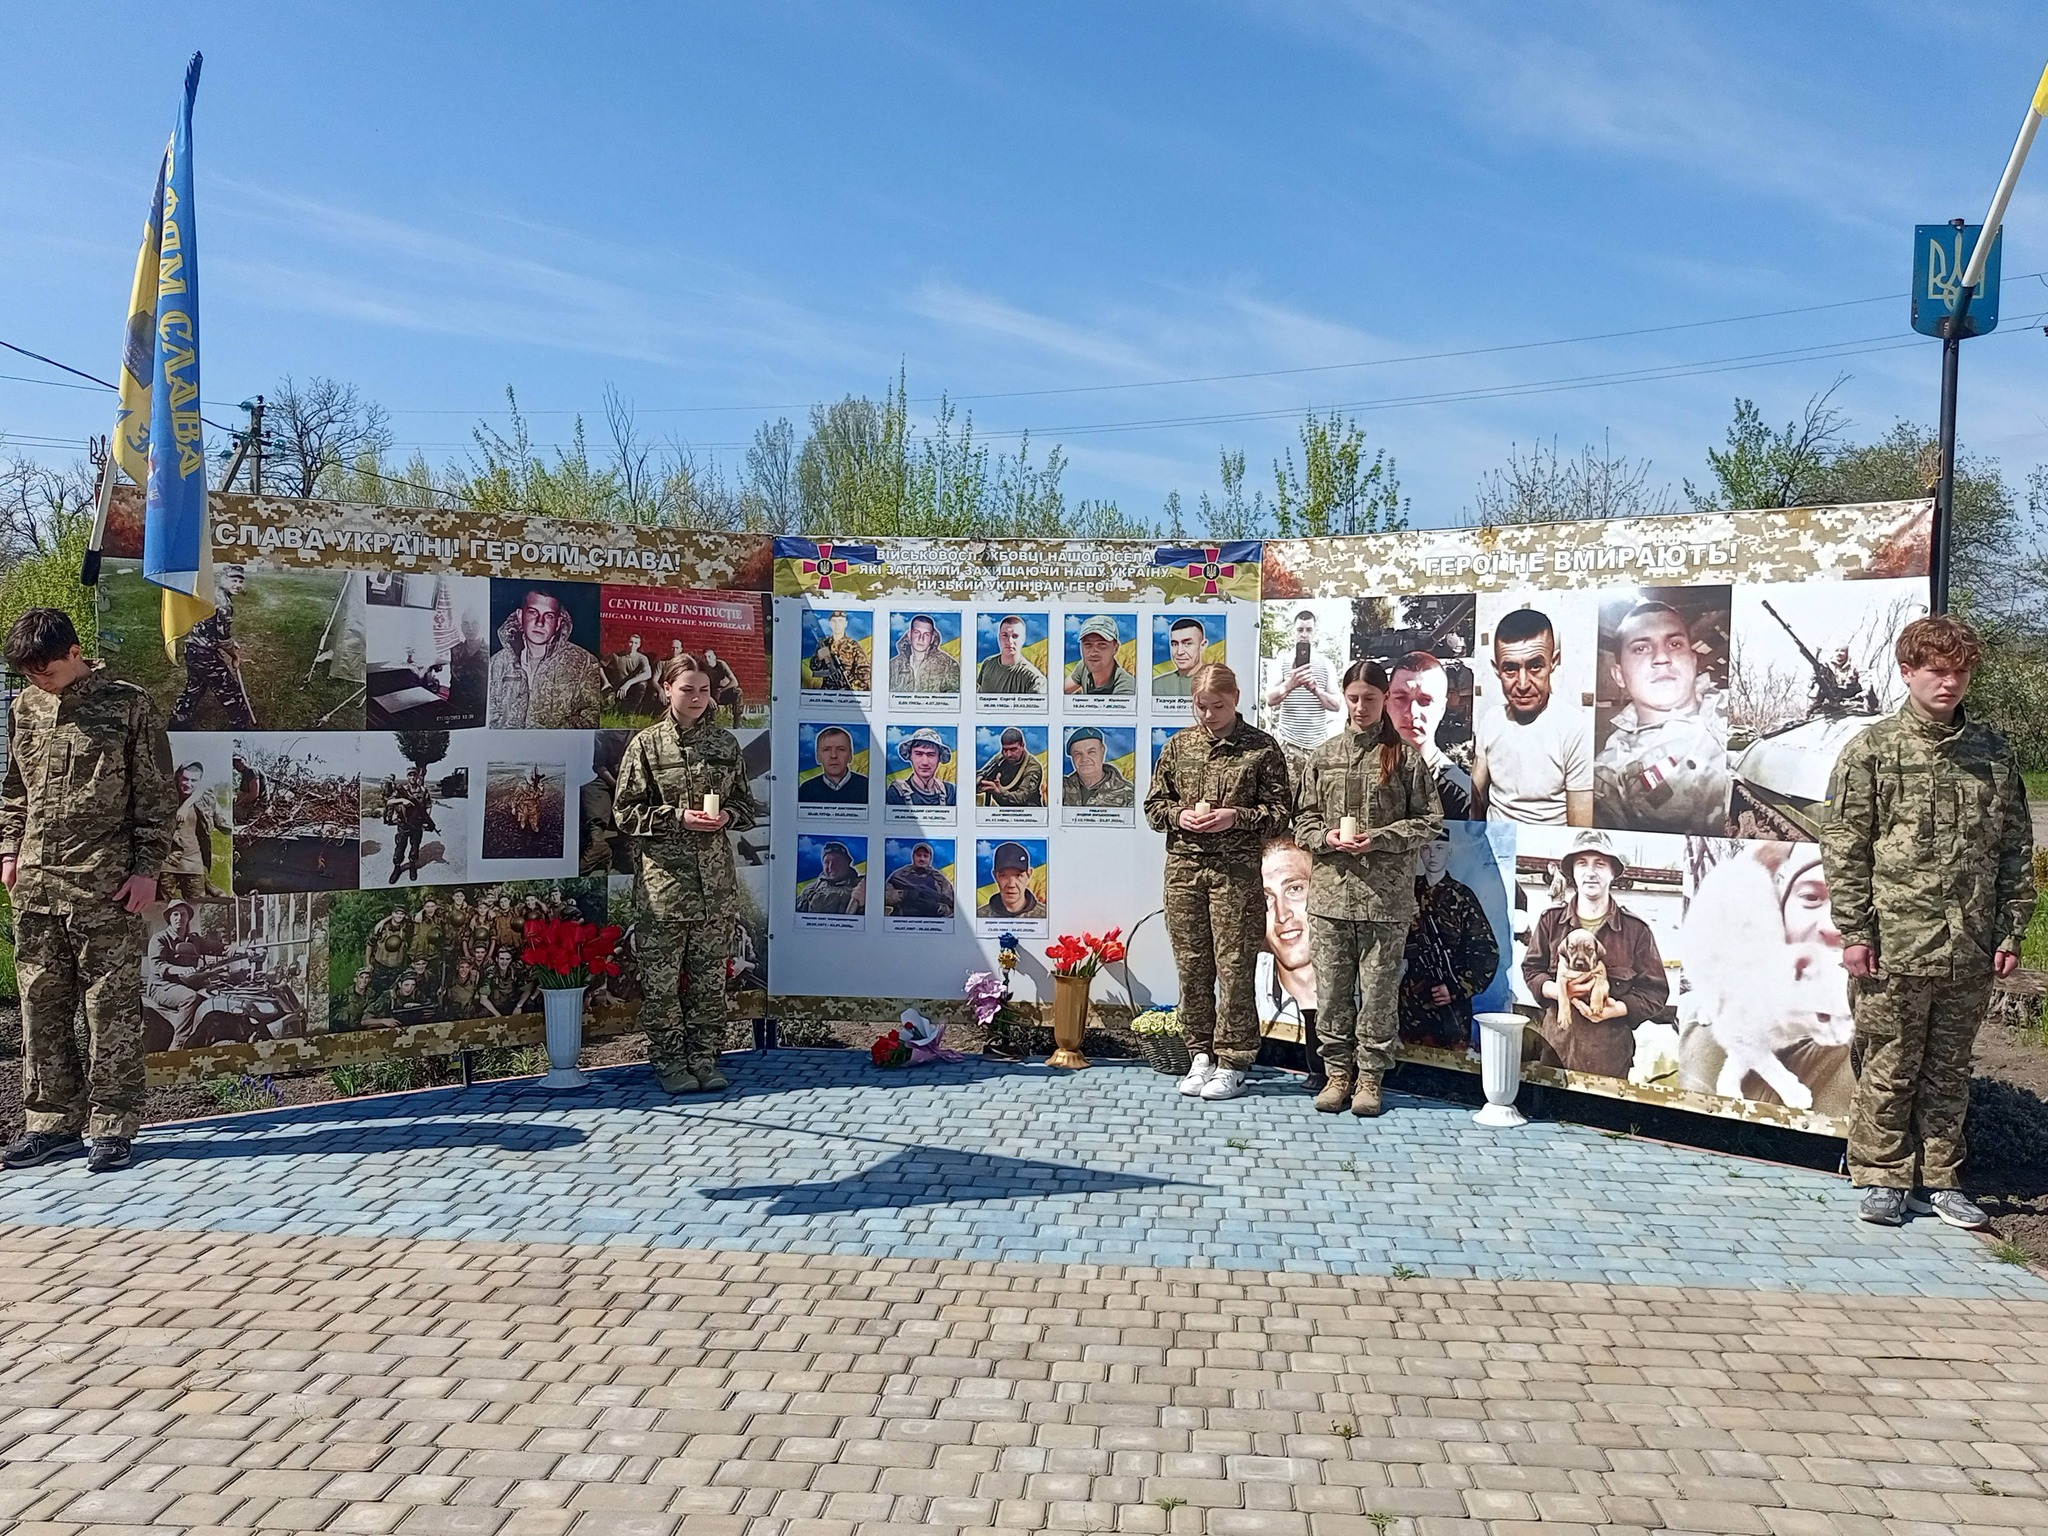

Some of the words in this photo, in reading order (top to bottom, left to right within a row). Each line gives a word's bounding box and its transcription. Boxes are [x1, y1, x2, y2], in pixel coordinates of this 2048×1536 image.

[159, 310, 201, 481] СЛАВА
[215, 523, 325, 551] СЛАВА
[334, 530, 461, 558] УКРАЇНІ!
[470, 539, 581, 566] ГЕРОЯМ
[588, 547, 681, 572] СЛАВА!
[876, 549, 1043, 565] ВІЙСЬКОВОСЛЖБОВЦІ
[1048, 550, 1110, 563] НАШОГО
[1114, 550, 1157, 565] СЕЛА,
[1424, 549, 1502, 578] ГЕРОЇ
[1507, 552, 1546, 575] НЕ
[1553, 541, 1738, 573] ВМИРАЮТЬ!
[859, 564, 883, 576] ЯКІ
[886, 564, 961, 577] ЗАГИНУЛИ
[964, 564, 1060, 579] ЗАХИЩАЮЧИ
[1063, 565, 1106, 577] НАШУ
[917, 578, 984, 591] НИЗЬКИЙ
[988, 580, 1030, 592] УКЛІН
[1033, 580, 1065, 592] ВАМ
[608, 598, 662, 613] CENTRUL
[664, 603, 679, 614] DE
[645, 615, 698, 627] INFANTERIE
